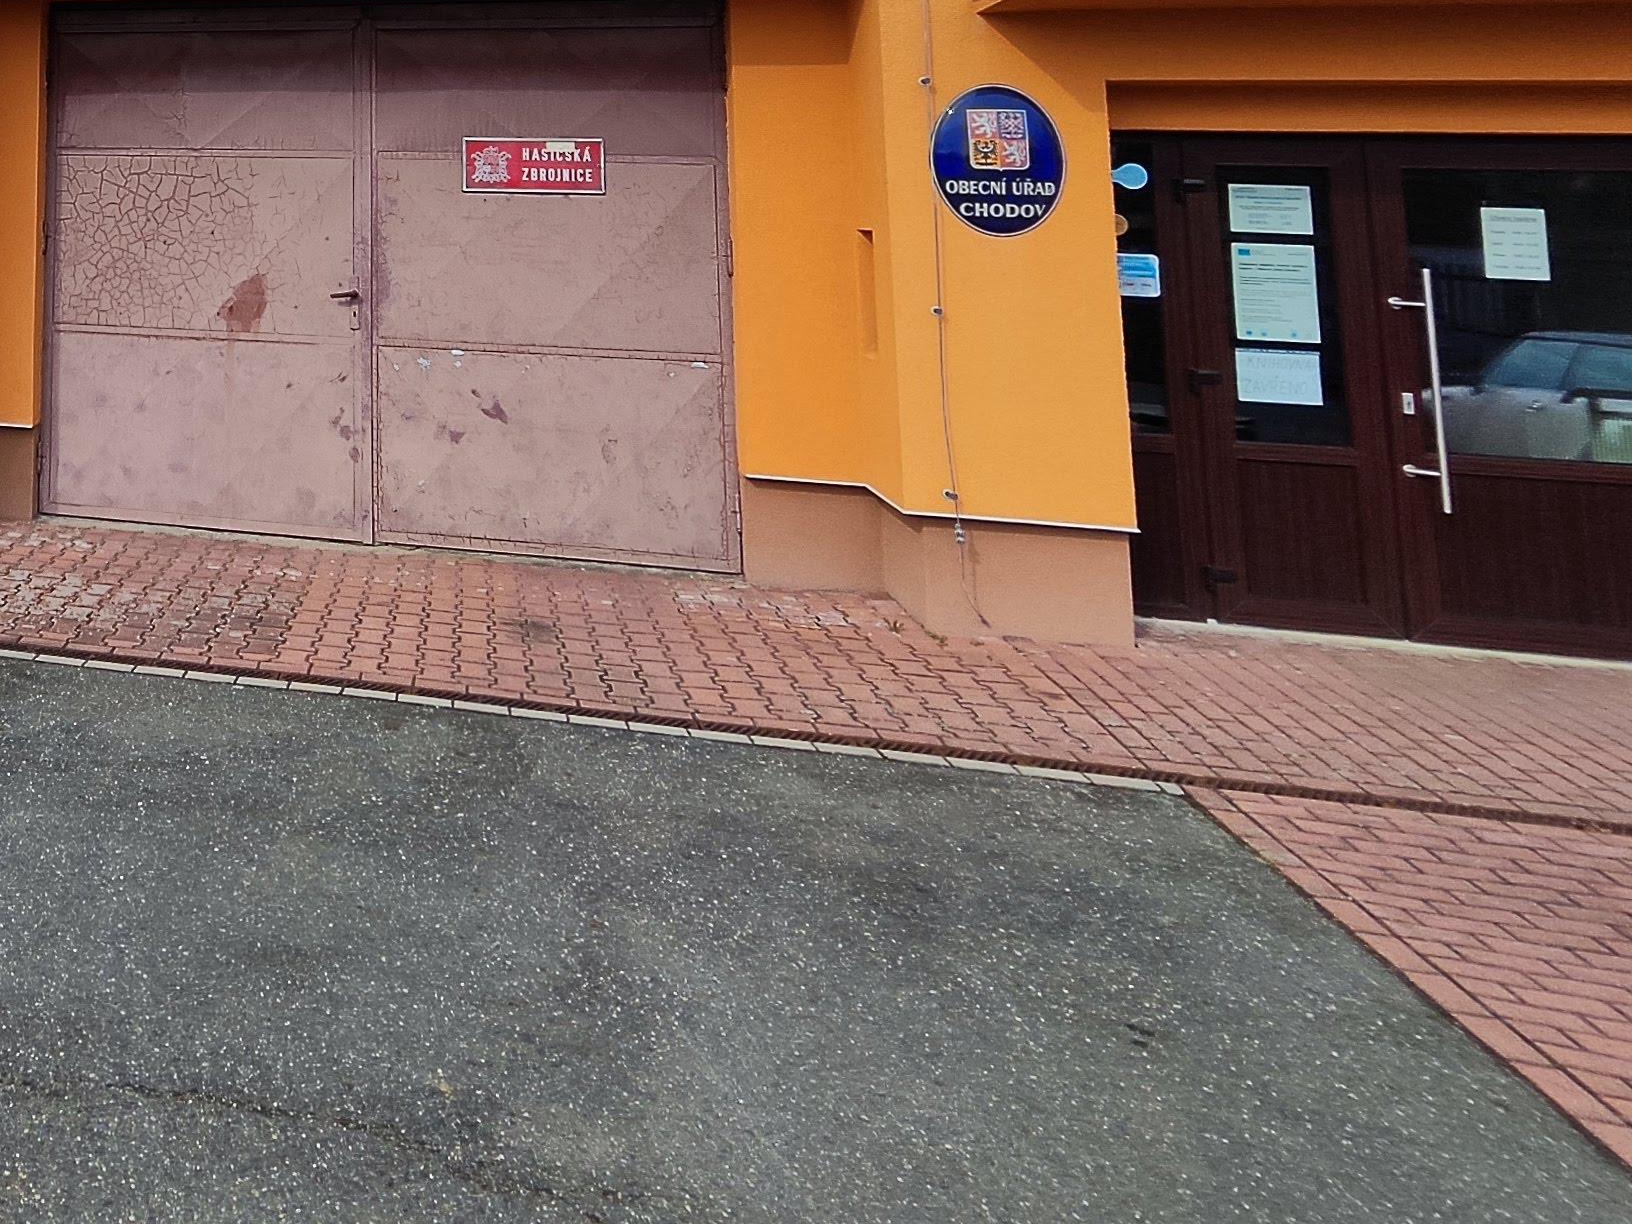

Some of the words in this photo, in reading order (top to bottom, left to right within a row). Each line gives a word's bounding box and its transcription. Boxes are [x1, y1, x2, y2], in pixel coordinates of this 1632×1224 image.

[521, 167, 593, 183] ZBROJNICE
[945, 178, 1006, 195] OBECNÍ
[1012, 178, 1056, 196] ÚŘAD
[959, 202, 1046, 218] CHODOV
